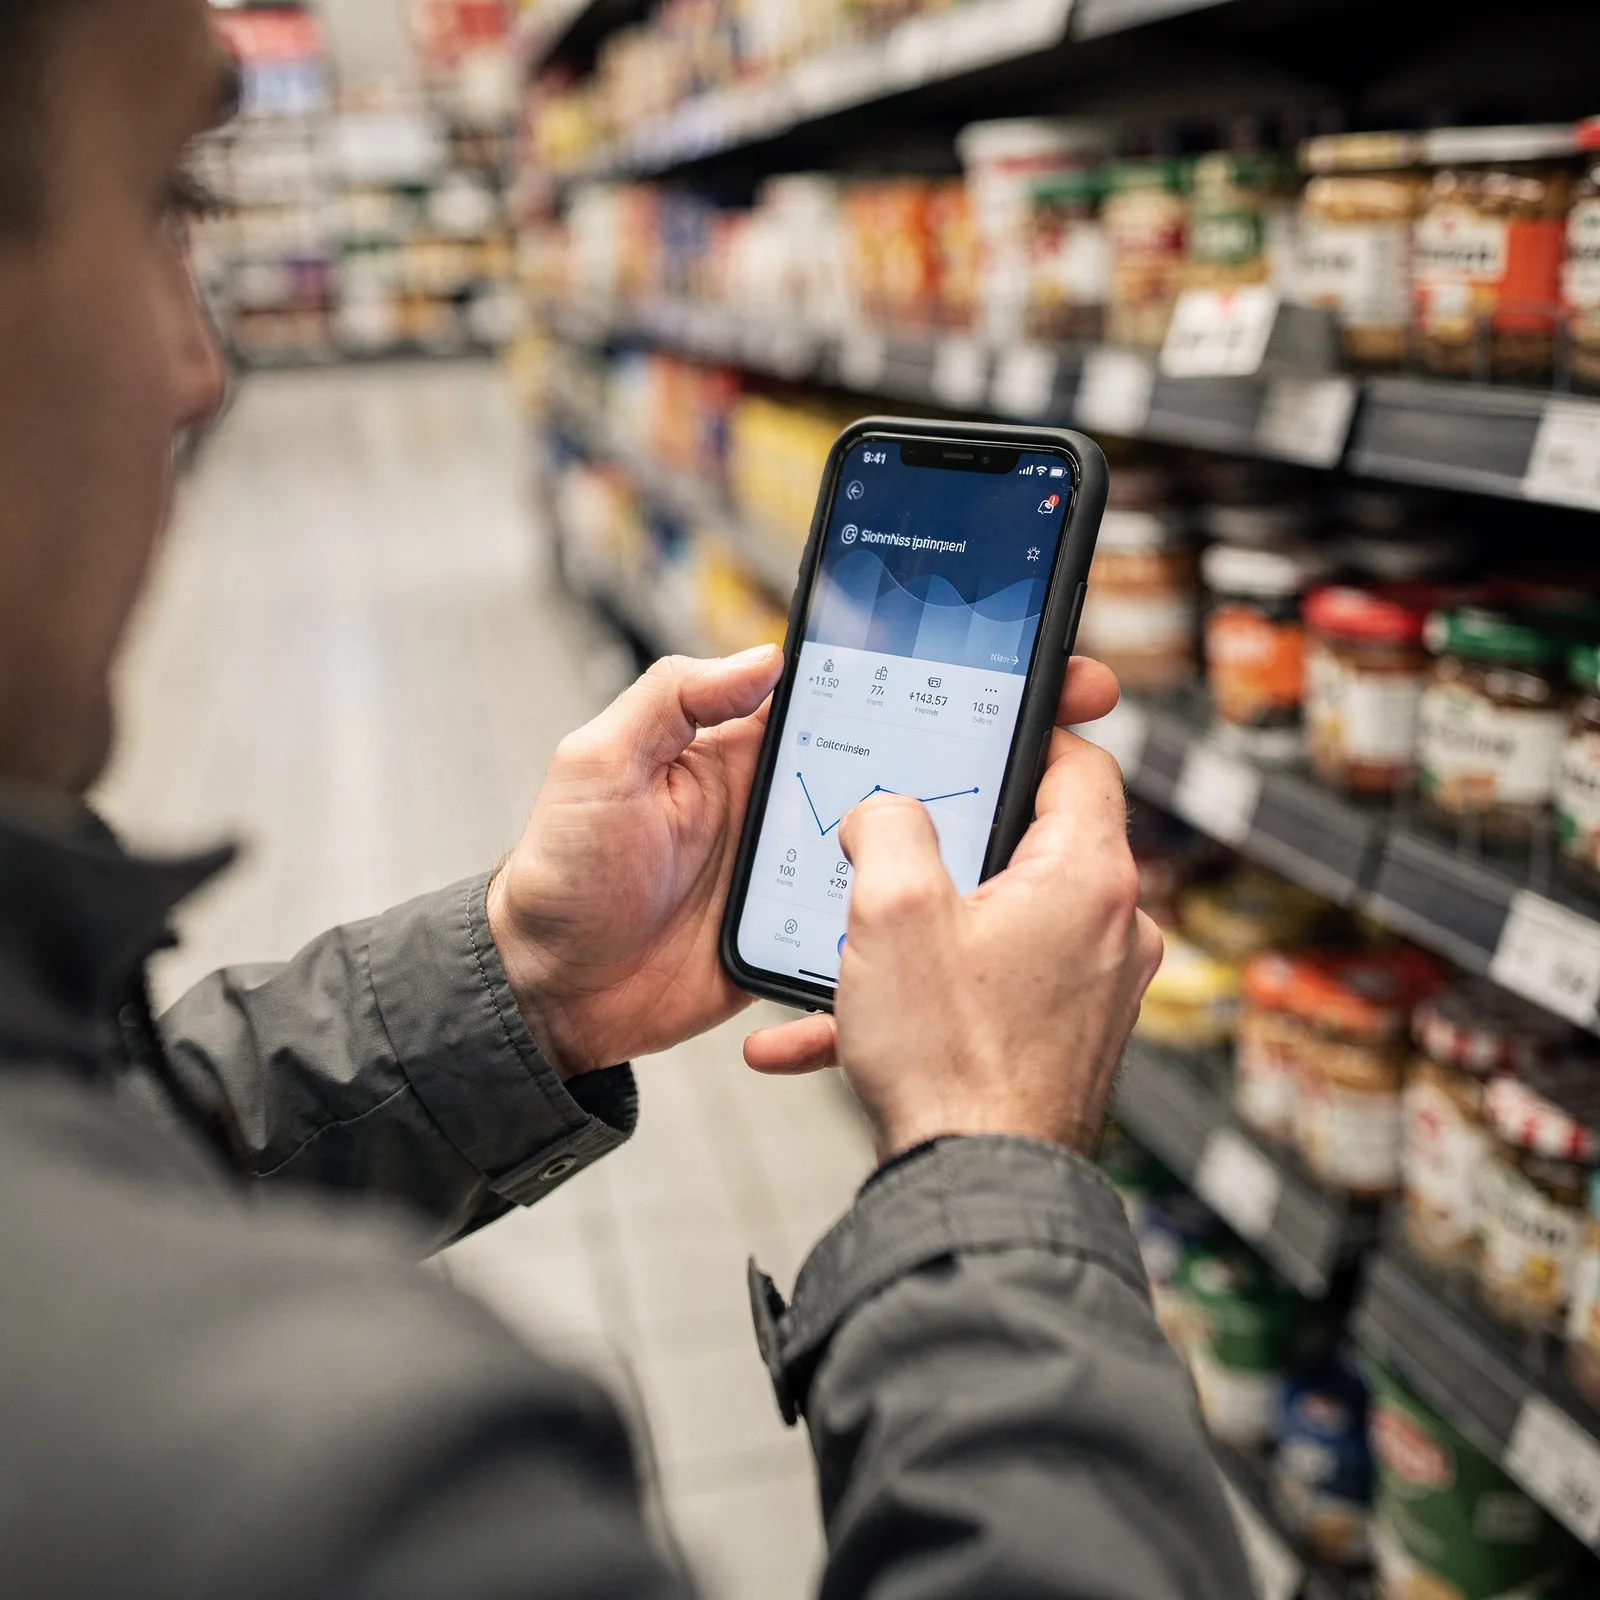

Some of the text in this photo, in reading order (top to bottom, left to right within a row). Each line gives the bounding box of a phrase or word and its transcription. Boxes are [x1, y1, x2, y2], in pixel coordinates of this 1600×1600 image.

[863, 451, 886, 464] 9:41
[779, 864, 795, 877] 100
[829, 877, 848, 890] +29
